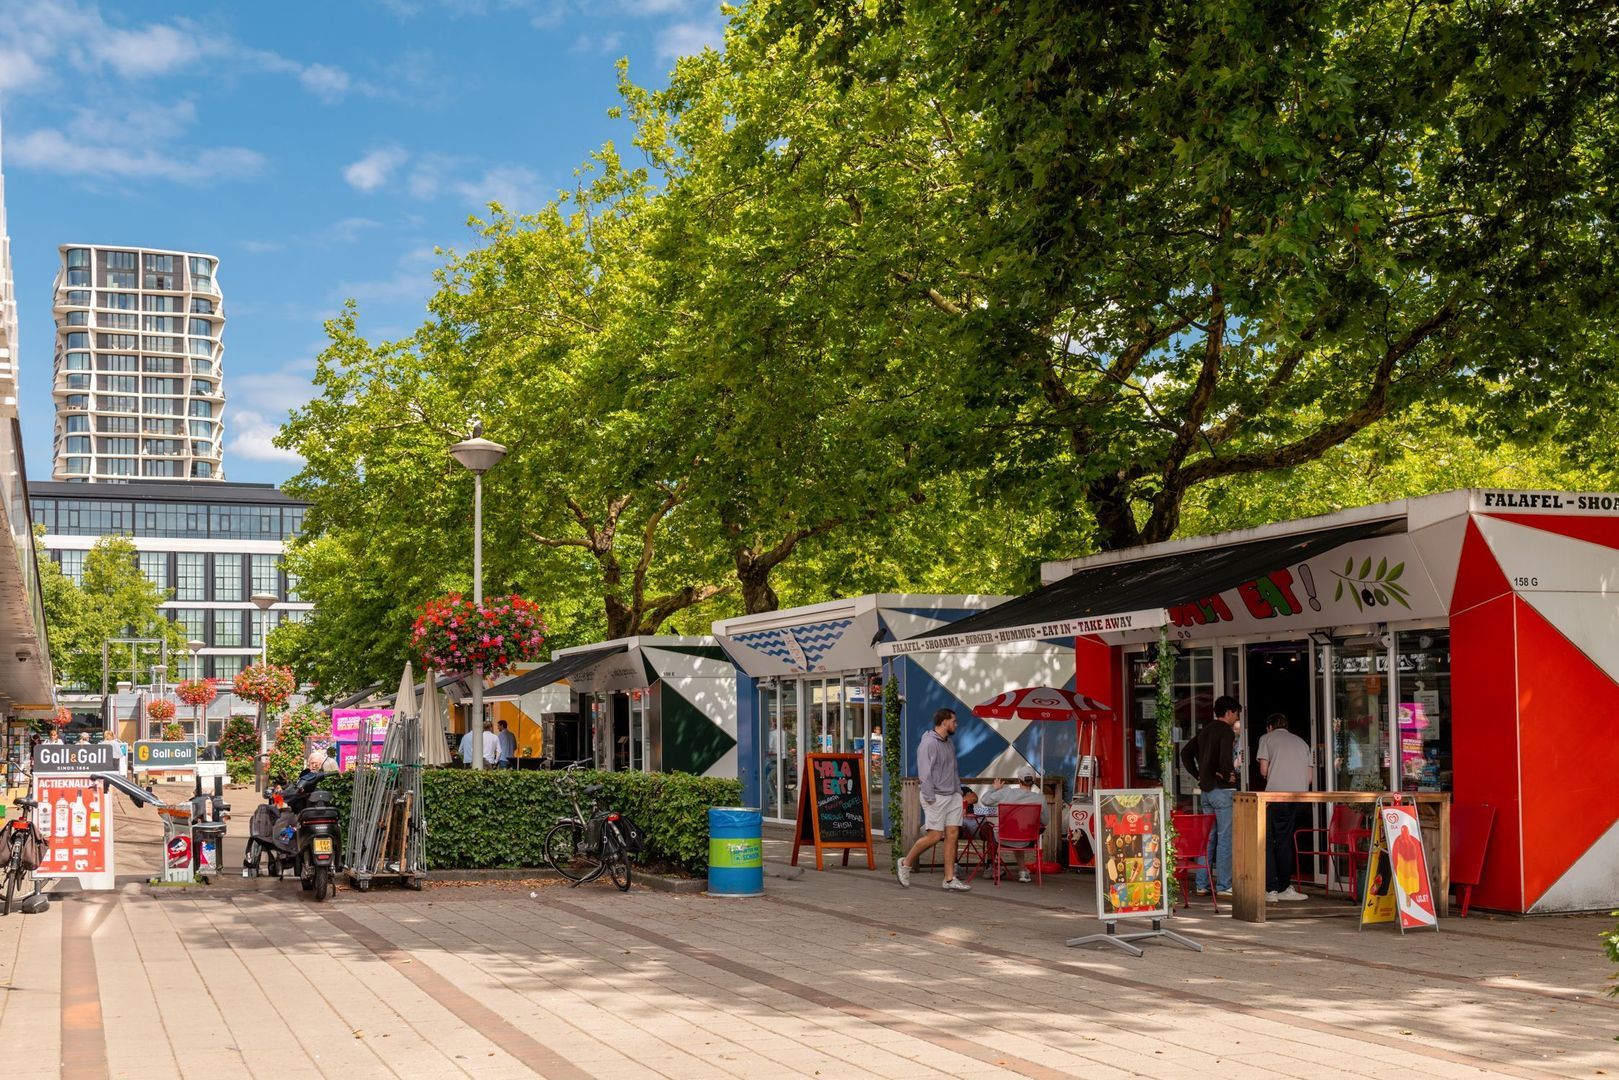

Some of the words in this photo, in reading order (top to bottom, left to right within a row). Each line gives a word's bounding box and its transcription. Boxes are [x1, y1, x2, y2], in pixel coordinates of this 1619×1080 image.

[1484, 492, 1564, 509] FALAFEL
[1514, 577, 1529, 587] 158
[1531, 577, 1538, 587] G
[892, 643, 921, 654] FALAFEL
[925, 636, 961, 650] SHOARMA
[999, 627, 1036, 642] HUMMUS
[1042, 625, 1059, 637] EAT
[1060, 623, 1071, 635] IN
[1078, 618, 1104, 633] TAKE
[1105, 615, 1132, 630] AWAY
[40, 748, 107, 765] Gall&Gall
[822, 778, 853, 795] EAT!
